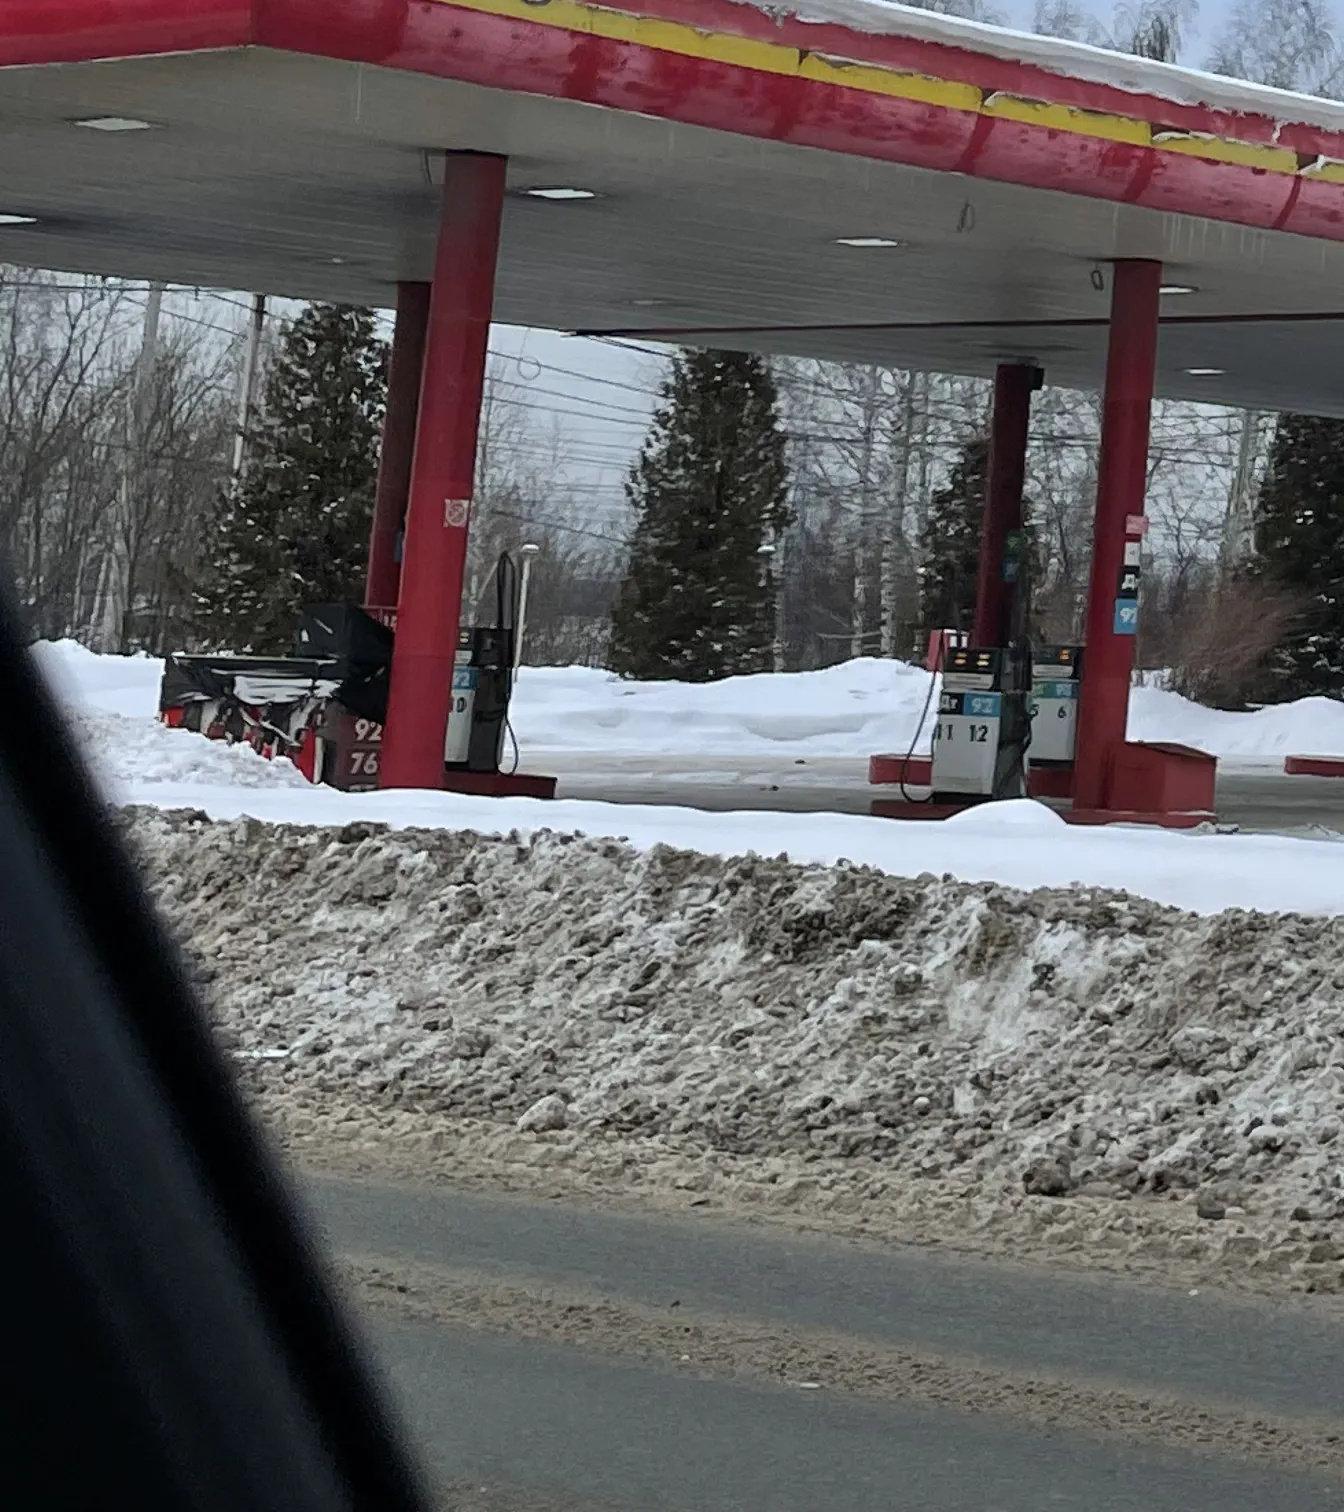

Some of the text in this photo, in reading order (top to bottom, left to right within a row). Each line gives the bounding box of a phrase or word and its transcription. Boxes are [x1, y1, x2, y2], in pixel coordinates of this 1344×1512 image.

[1057, 705, 1067, 719] 6
[354, 718, 383, 741] 92
[969, 724, 988, 742] 12
[350, 752, 378, 774] 76
